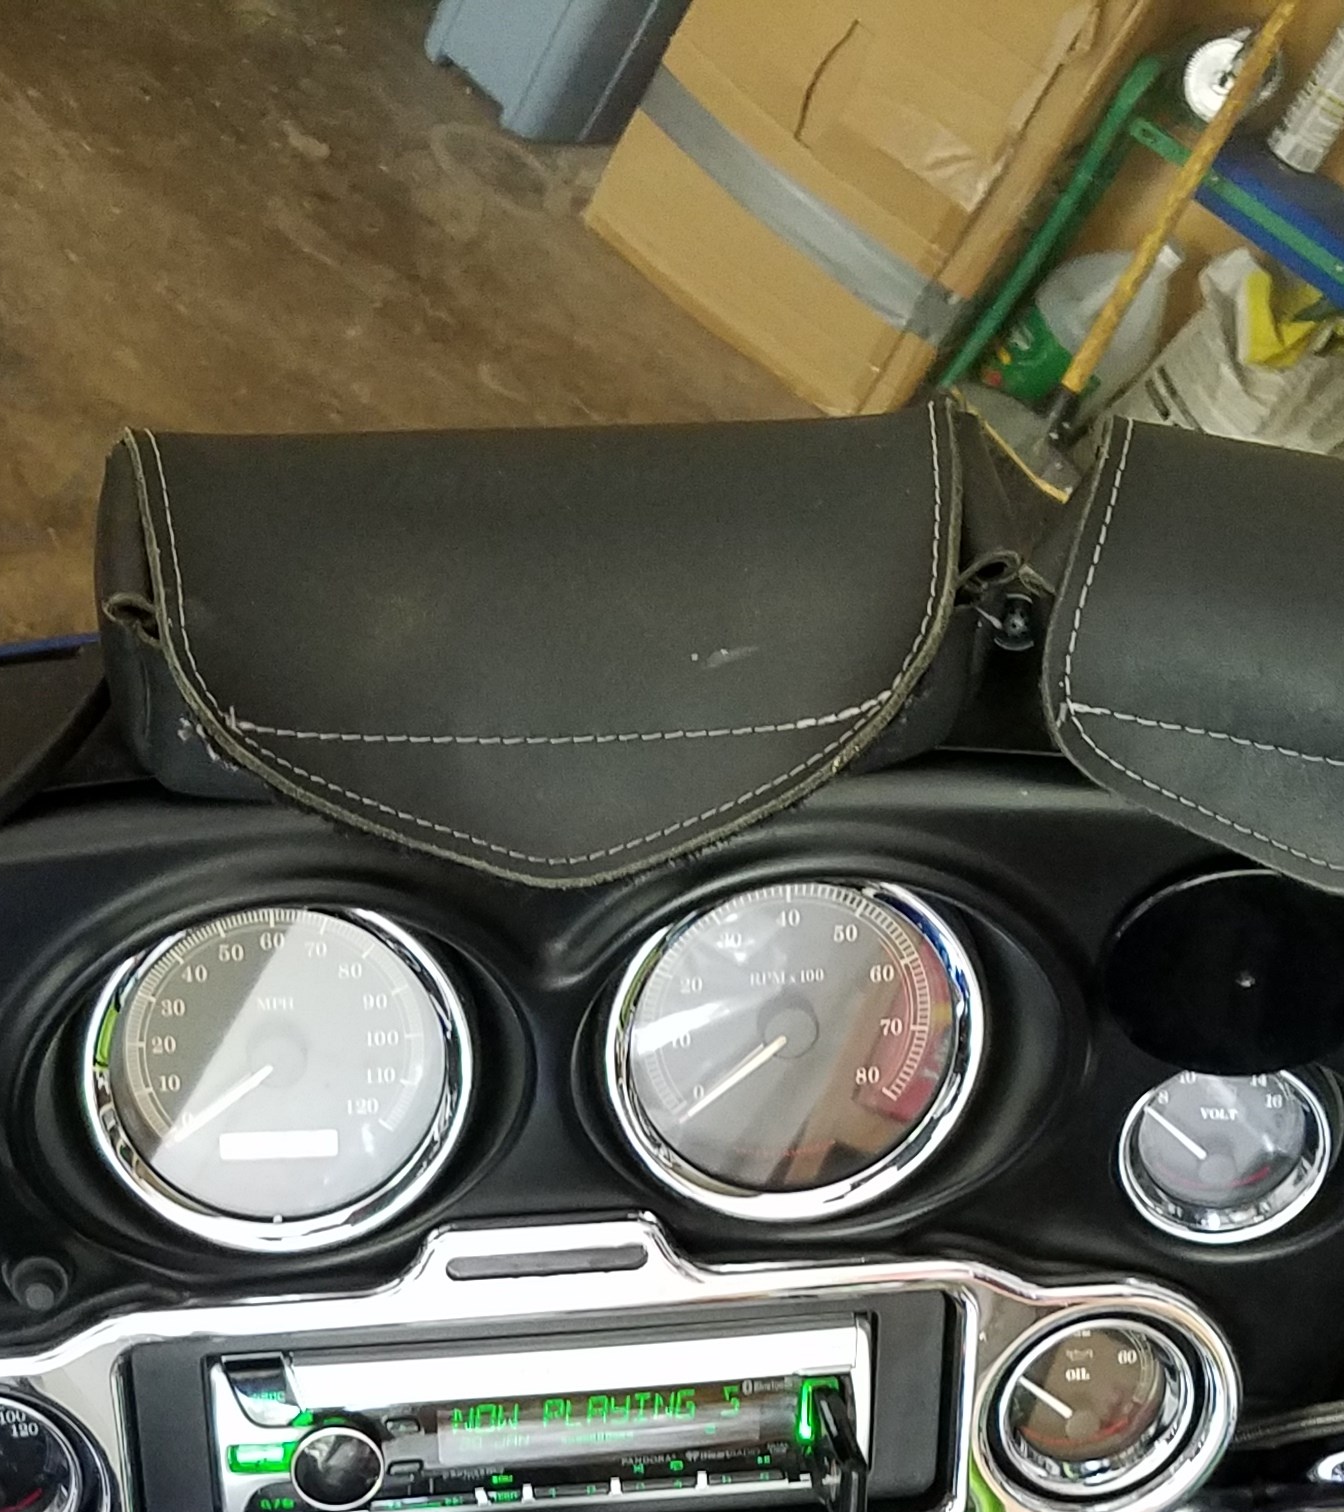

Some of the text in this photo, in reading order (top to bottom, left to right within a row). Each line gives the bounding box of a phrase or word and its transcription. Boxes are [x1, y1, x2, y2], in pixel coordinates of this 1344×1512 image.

[259, 931, 286, 951] 60
[833, 924, 858, 943] 50
[217, 943, 245, 963] 50
[304, 941, 328, 959] 70
[181, 965, 208, 984] 40
[337, 962, 363, 981] 80
[749, 971, 786, 988] RPM
[799, 967, 825, 984] 100
[869, 964, 895, 983] 60
[679, 976, 703, 995] 20
[160, 999, 186, 1017] 30
[257, 996, 295, 1012] MPH
[362, 994, 388, 1011] 90
[879, 1018, 903, 1037] 70
[151, 1036, 176, 1054] 20
[365, 1030, 399, 1047] 100
[158, 1075, 181, 1092] 10
[365, 1068, 396, 1084] 110
[855, 1066, 880, 1085] 80
[691, 1083, 705, 1101] 0
[346, 1097, 379, 1116] 120
[1199, 1106, 1238, 1121] VOLT
[1117, 1349, 1138, 1366] 60
[1065, 1366, 1092, 1383] OIL
[451, 1402, 520, 1434] NOW
[542, 1388, 696, 1428] PLAYING
[10, 1421, 39, 1439] 120
